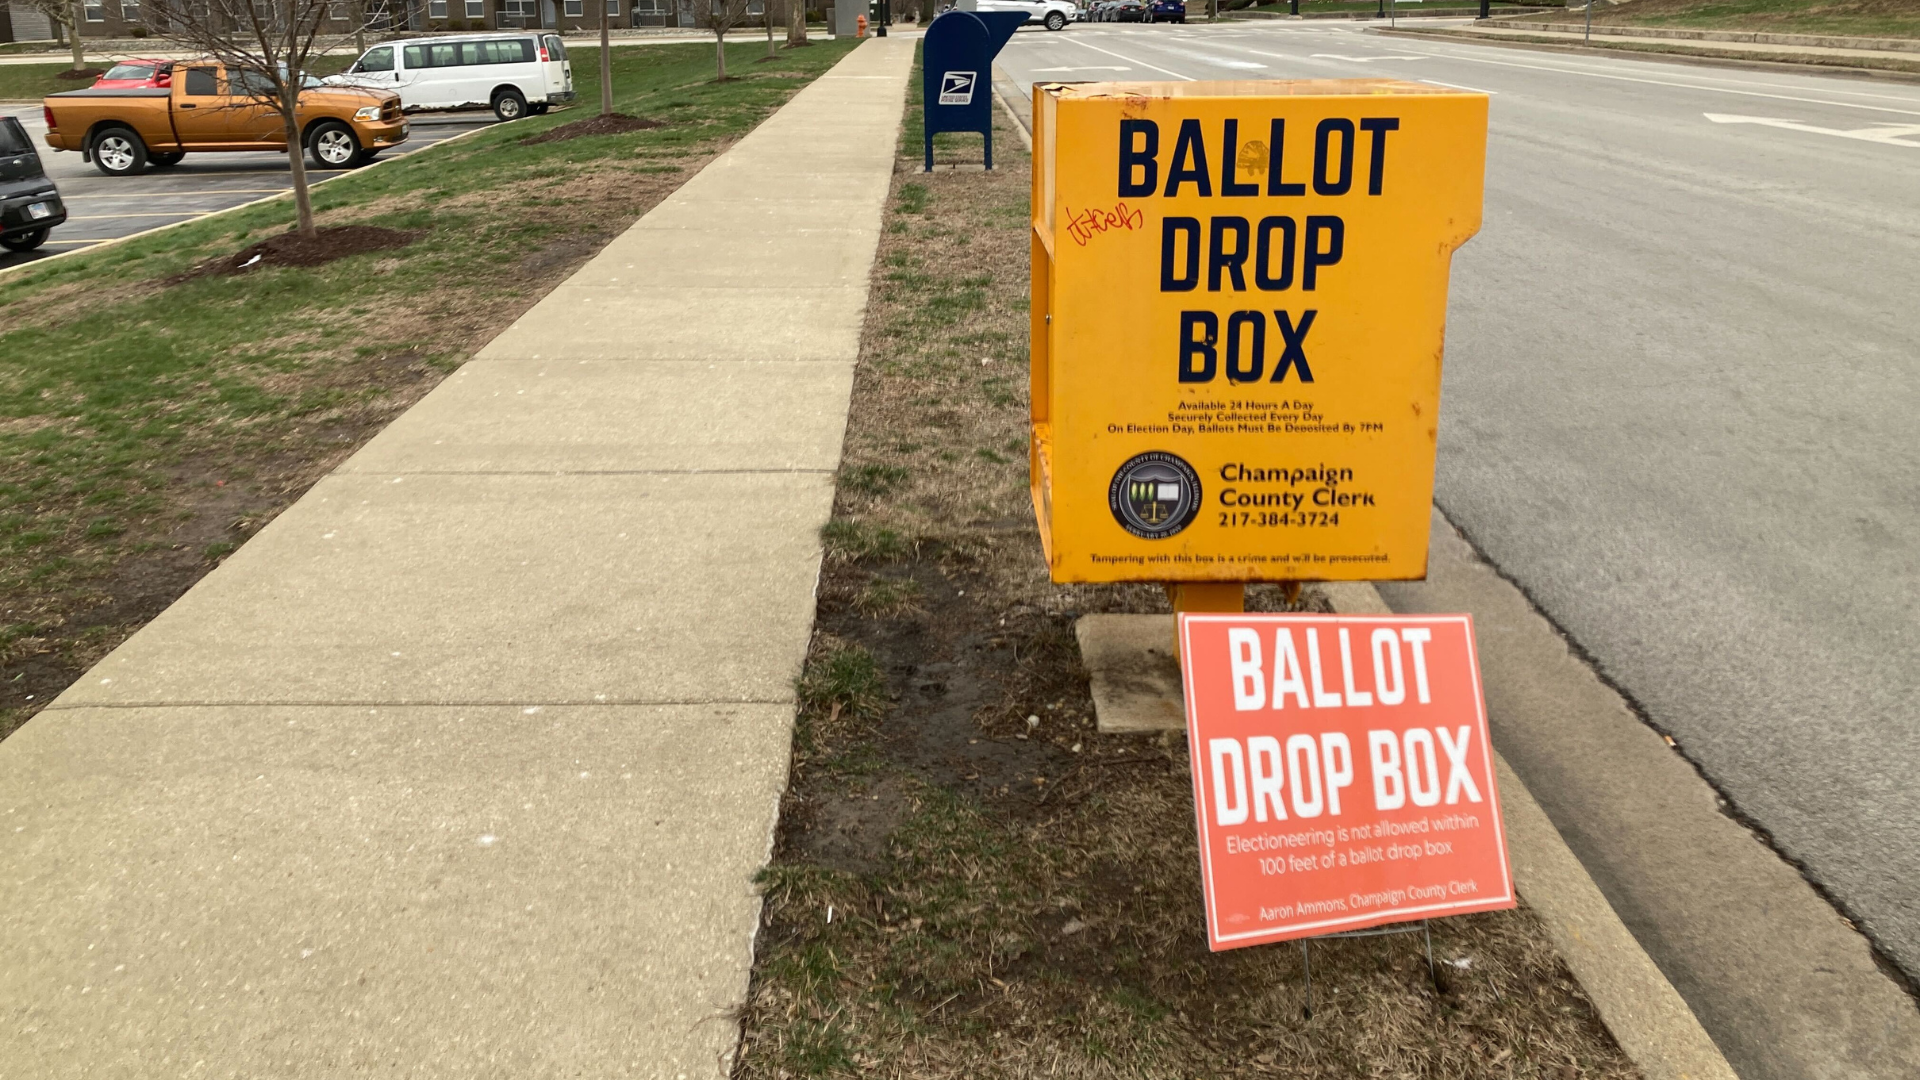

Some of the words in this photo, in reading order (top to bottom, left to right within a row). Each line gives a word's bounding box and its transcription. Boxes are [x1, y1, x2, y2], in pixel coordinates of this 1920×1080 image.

[1118, 117, 1400, 198] BALLOT
[1160, 215, 1345, 292] DROP
[1178, 310, 1318, 383] BOX
[1168, 411, 1213, 424] Securely
[1216, 411, 1267, 422] Collected
[1270, 411, 1299, 424] Every
[1303, 411, 1324, 424] Day
[1178, 400, 1226, 411] Available
[1229, 401, 1242, 411] 24
[1246, 400, 1278, 411] Hours
[1281, 401, 1290, 411] A
[1293, 400, 1314, 413] Day
[1107, 423, 1124, 434] On
[1127, 422, 1169, 434] Election
[1172, 423, 1195, 436] Day,
[1198, 423, 1235, 434] Ballots
[1238, 423, 1264, 433] Must
[1267, 423, 1282, 433] Be
[1285, 422, 1340, 434] Deposited
[1343, 423, 1356, 435] By
[1360, 422, 1384, 433] 7PM
[1220, 462, 1354, 488] Champaign
[1219, 487, 1304, 512] County
[1312, 487, 1376, 507] Clerk
[1218, 512, 1340, 527] 217-384-3724
[1090, 553, 1145, 566] Tampering
[1147, 553, 1171, 564] with
[1174, 553, 1192, 564] this
[1195, 553, 1214, 564] box
[1217, 553, 1226, 563] is
[1228, 555, 1235, 563] a
[1237, 553, 1267, 564] crime
[1270, 553, 1289, 563] and
[1293, 553, 1310, 563] will
[1314, 553, 1326, 563] be
[1329, 553, 1391, 566] prosecuted.
[1228, 627, 1431, 711] BALLOT
[1209, 731, 1354, 826] DROP
[1367, 725, 1483, 811] BOX
[1226, 827, 1335, 854] Electioneering
[1337, 825, 1350, 842] is
[1350, 824, 1372, 841] not
[1373, 816, 1430, 837] allowed
[1432, 813, 1480, 832] within
[1259, 855, 1286, 876] 100
[1288, 853, 1319, 872] feet
[1321, 849, 1336, 869] of
[1338, 852, 1348, 867] a
[1349, 846, 1385, 865] ballot
[1387, 841, 1423, 861] drop
[1424, 839, 1453, 856] box
[1259, 904, 1294, 921] Aaron
[1297, 899, 1349, 916] Ammons,
[1349, 889, 1406, 908] Champaign
[1407, 884, 1447, 901] County
[1448, 879, 1479, 895] Clerk
